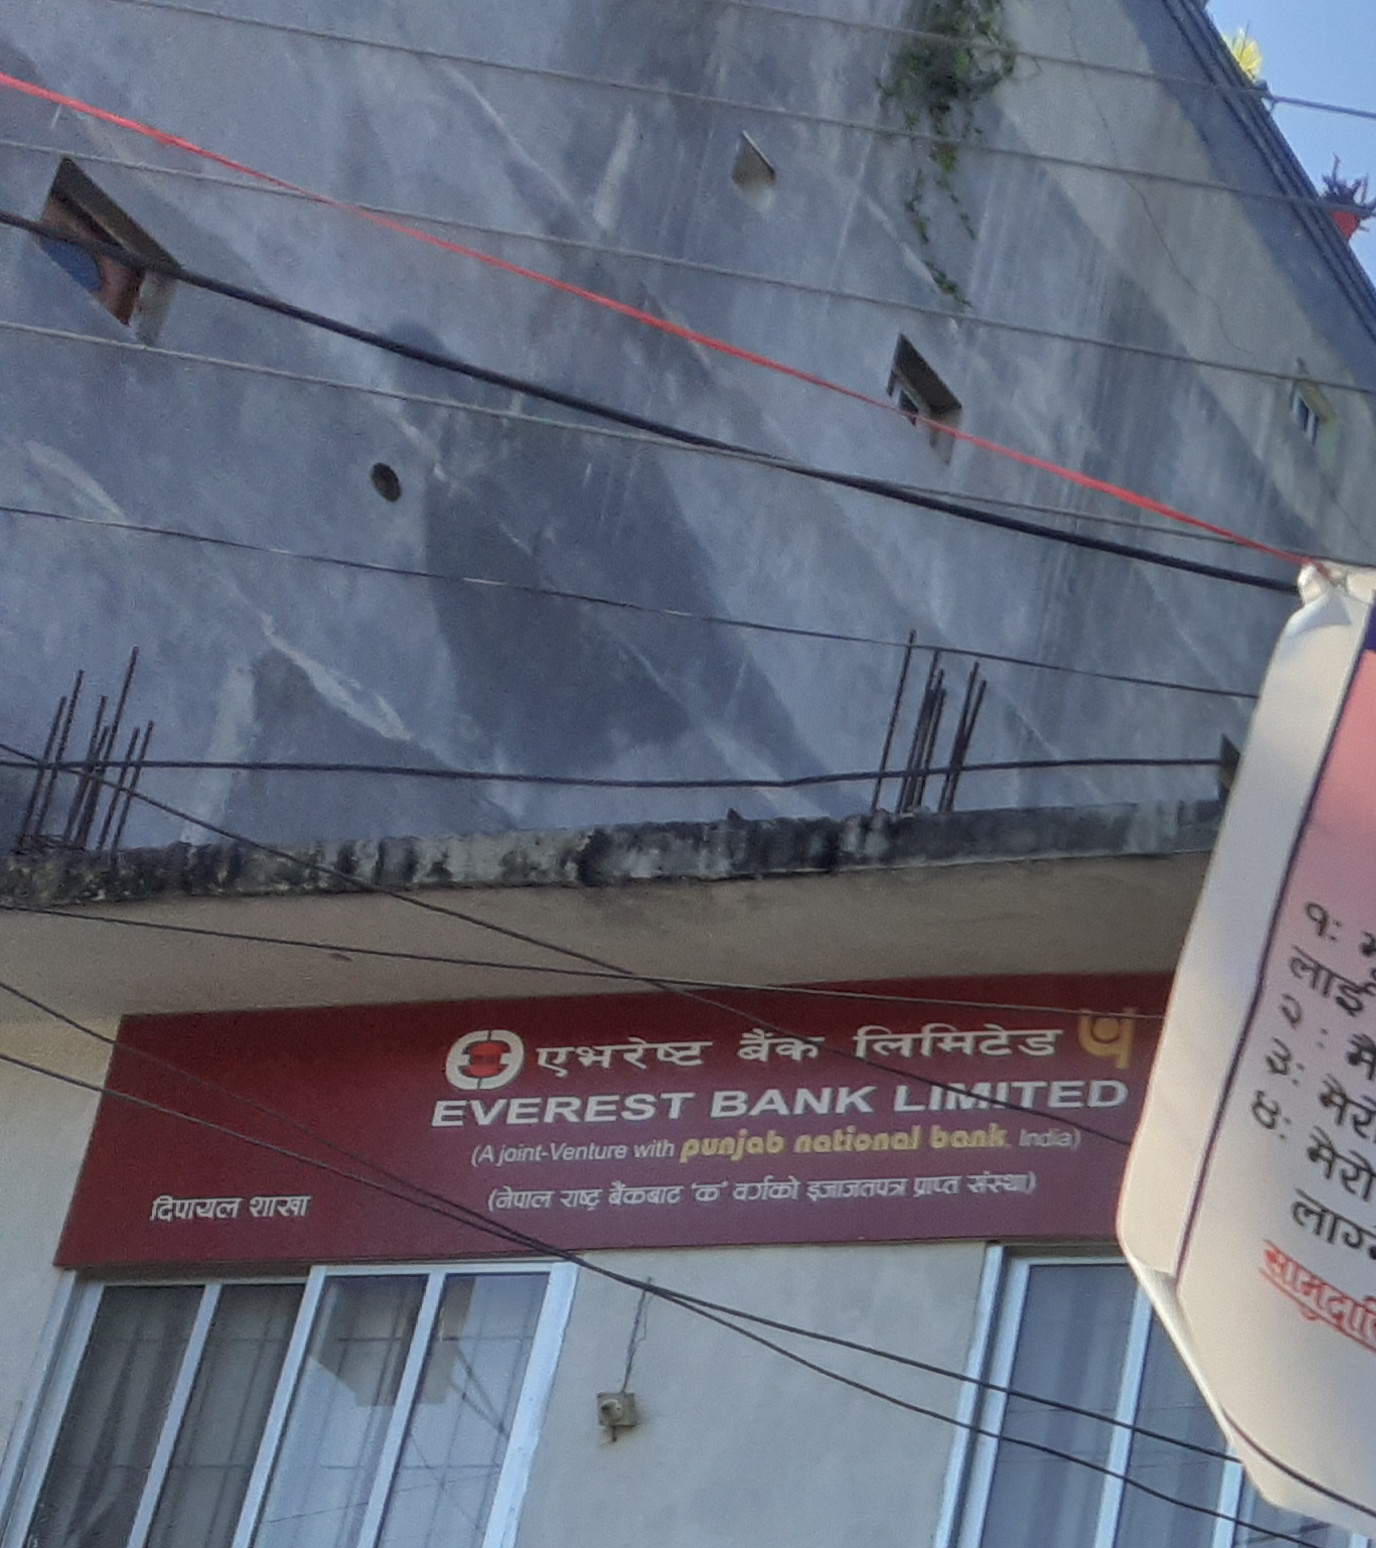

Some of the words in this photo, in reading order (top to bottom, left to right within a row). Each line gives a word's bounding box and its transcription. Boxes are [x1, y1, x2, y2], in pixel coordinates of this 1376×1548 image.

[536, 1036, 714, 1078] एभरेष्ट
[737, 1028, 825, 1062] बैंक
[853, 1023, 1064, 1059] लिमिटेड
[431, 1091, 695, 1128] EVEREST
[710, 1085, 877, 1119] BANK
[893, 1079, 1130, 1113] LIMITED
[633, 1139, 676, 1159] with
[679, 1129, 786, 1164] punjab
[793, 1125, 922, 1154] national
[149, 1194, 242, 1222] दिपायल
[249, 1194, 311, 1218] शाखा
